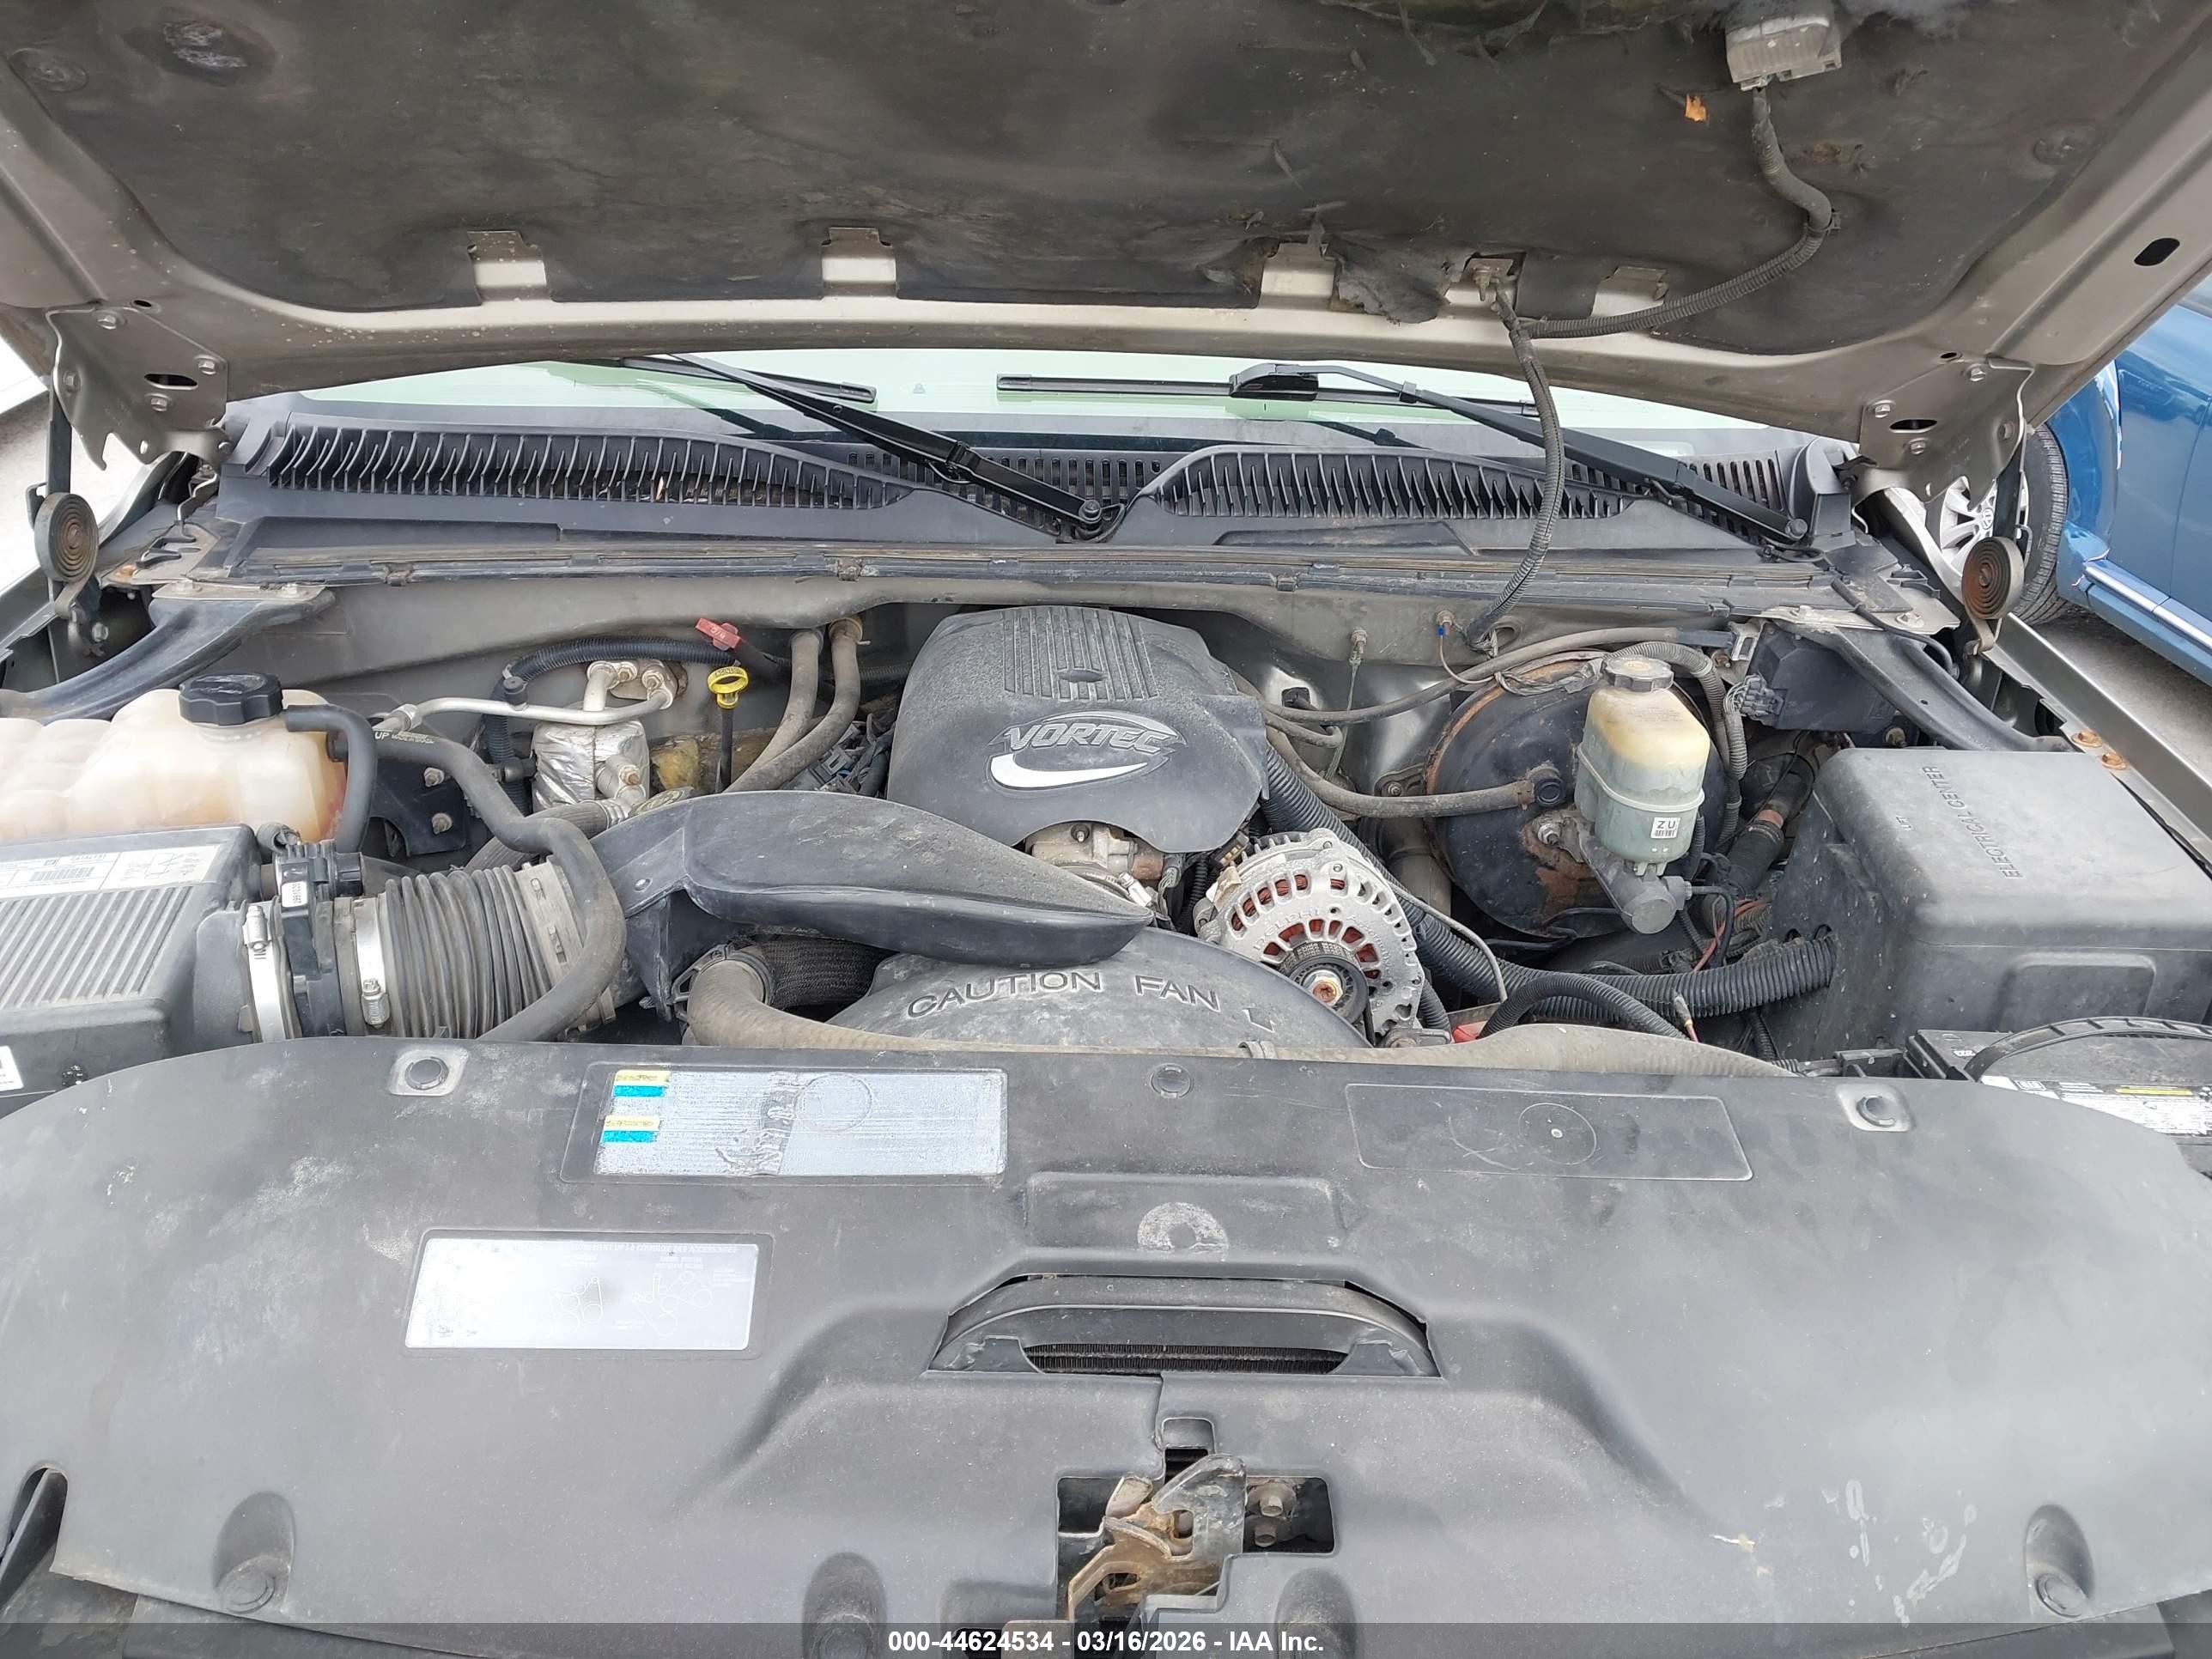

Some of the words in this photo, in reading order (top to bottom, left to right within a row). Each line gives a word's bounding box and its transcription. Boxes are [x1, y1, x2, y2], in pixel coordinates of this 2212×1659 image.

[374, 730, 390, 740] UP
[1003, 722, 1171, 755] VORTEC
[1922, 765, 1966, 809] CENTER
[1895, 815, 1912, 830] LIFT
[1957, 811, 2024, 878] ELECTRICAL
[907, 971, 1103, 1019] CAUTION
[1134, 974, 1220, 1012] FAN
